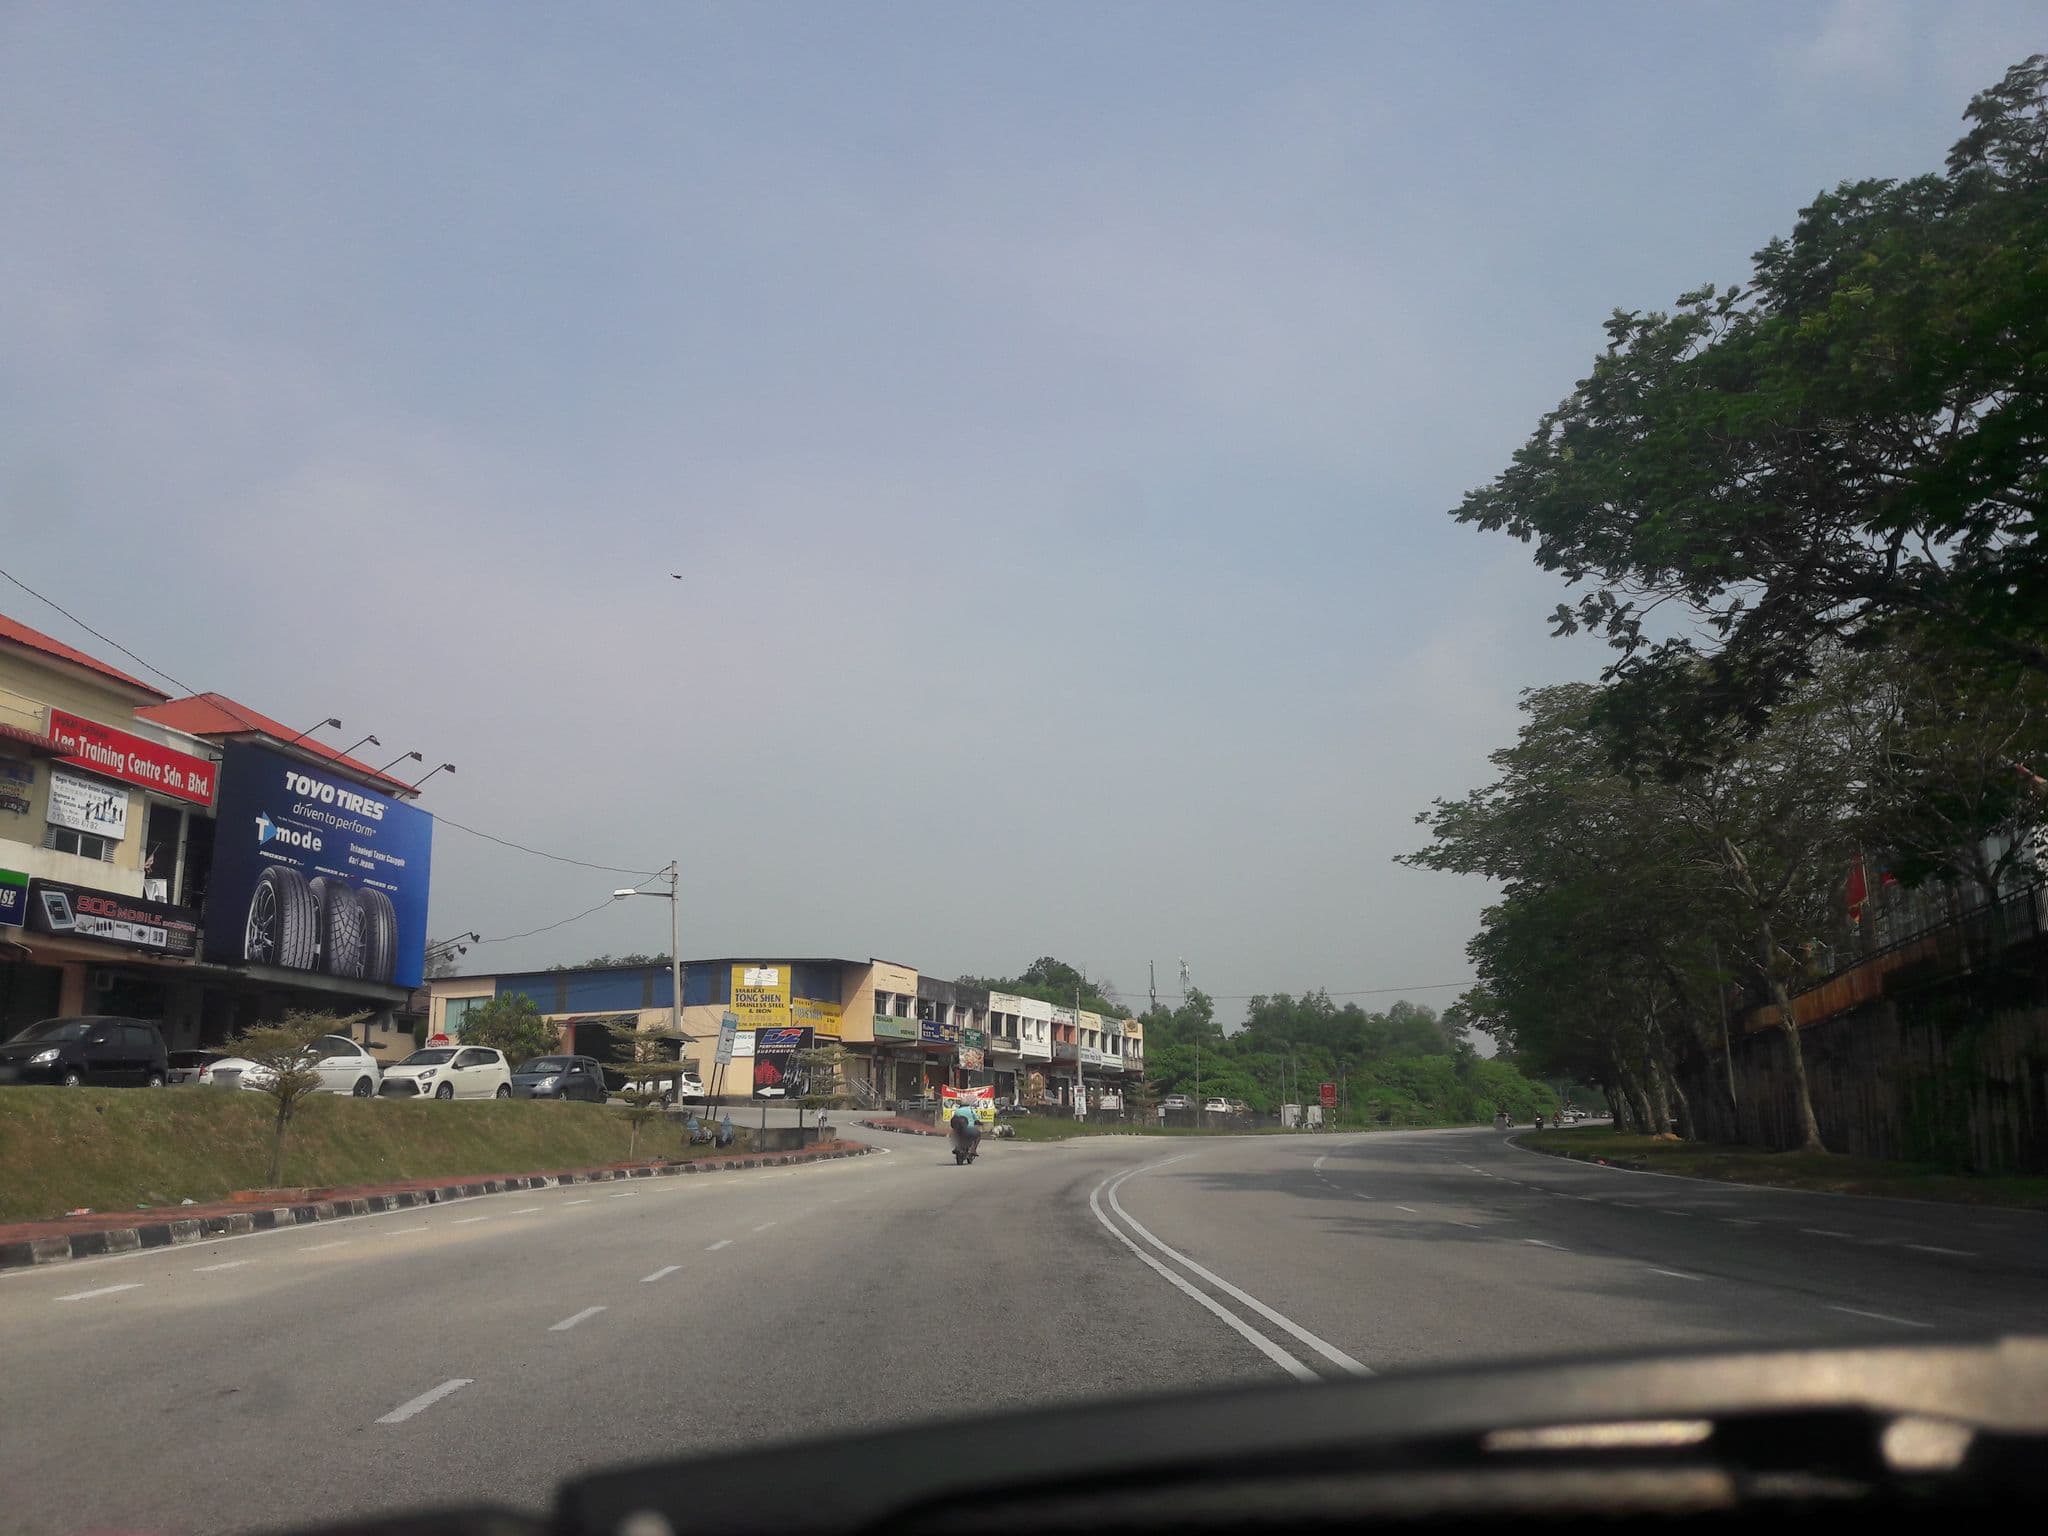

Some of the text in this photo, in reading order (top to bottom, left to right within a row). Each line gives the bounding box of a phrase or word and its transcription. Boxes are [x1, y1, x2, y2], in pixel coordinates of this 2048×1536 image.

[79, 736, 125, 774] Training
[128, 753, 161, 780] Centre
[163, 763, 184, 789] Sdn.
[188, 772, 209, 796] Bhd.
[286, 771, 385, 821] TOYO TIRES
[292, 802, 324, 822] driven
[325, 812, 336, 825] to
[335, 819, 373, 837] perform
[276, 827, 322, 851] mode
[735, 994, 781, 1002] TONG SHEN
